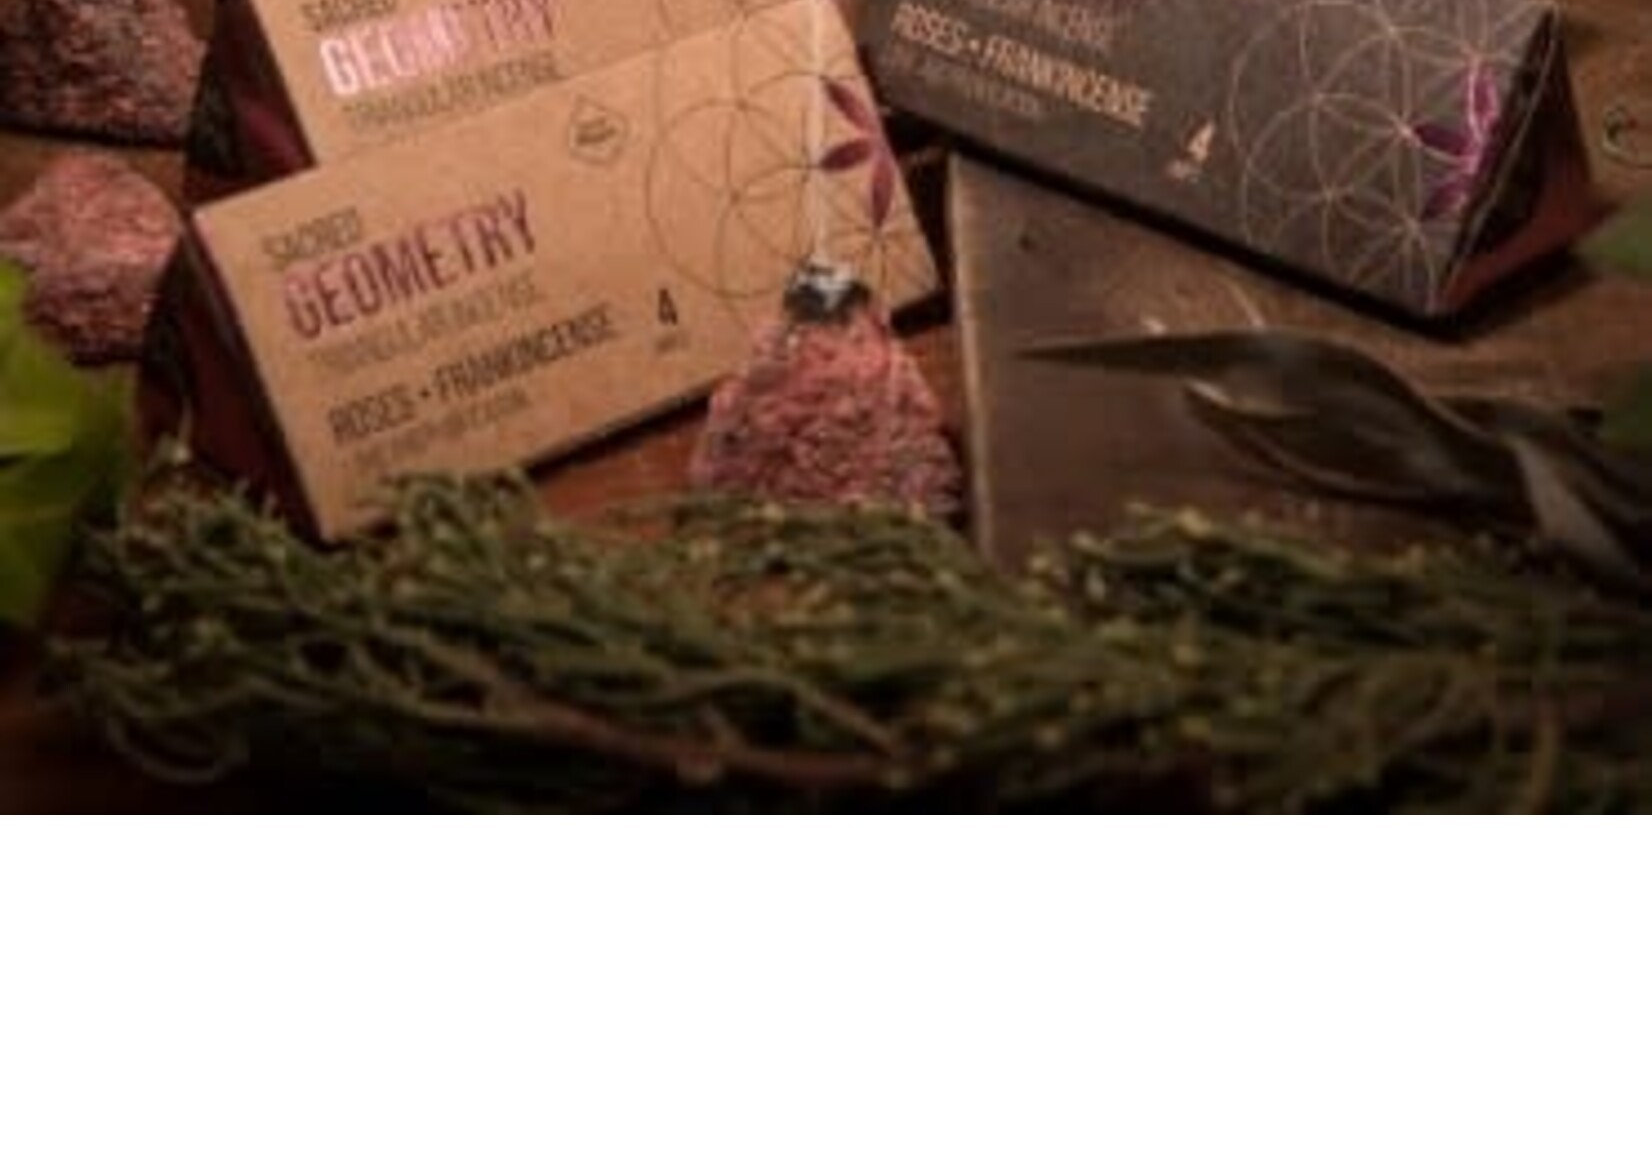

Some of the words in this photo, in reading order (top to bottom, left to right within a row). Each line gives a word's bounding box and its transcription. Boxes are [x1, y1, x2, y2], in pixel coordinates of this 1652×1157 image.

[892, 2, 968, 55] ROSES
[1188, 121, 1214, 163] 4
[262, 207, 364, 272] SACRED
[284, 188, 536, 341] GEOMETRY
[656, 287, 679, 326] 4
[327, 382, 417, 443] ROSES
[430, 304, 616, 400] FRANKINCENSE
